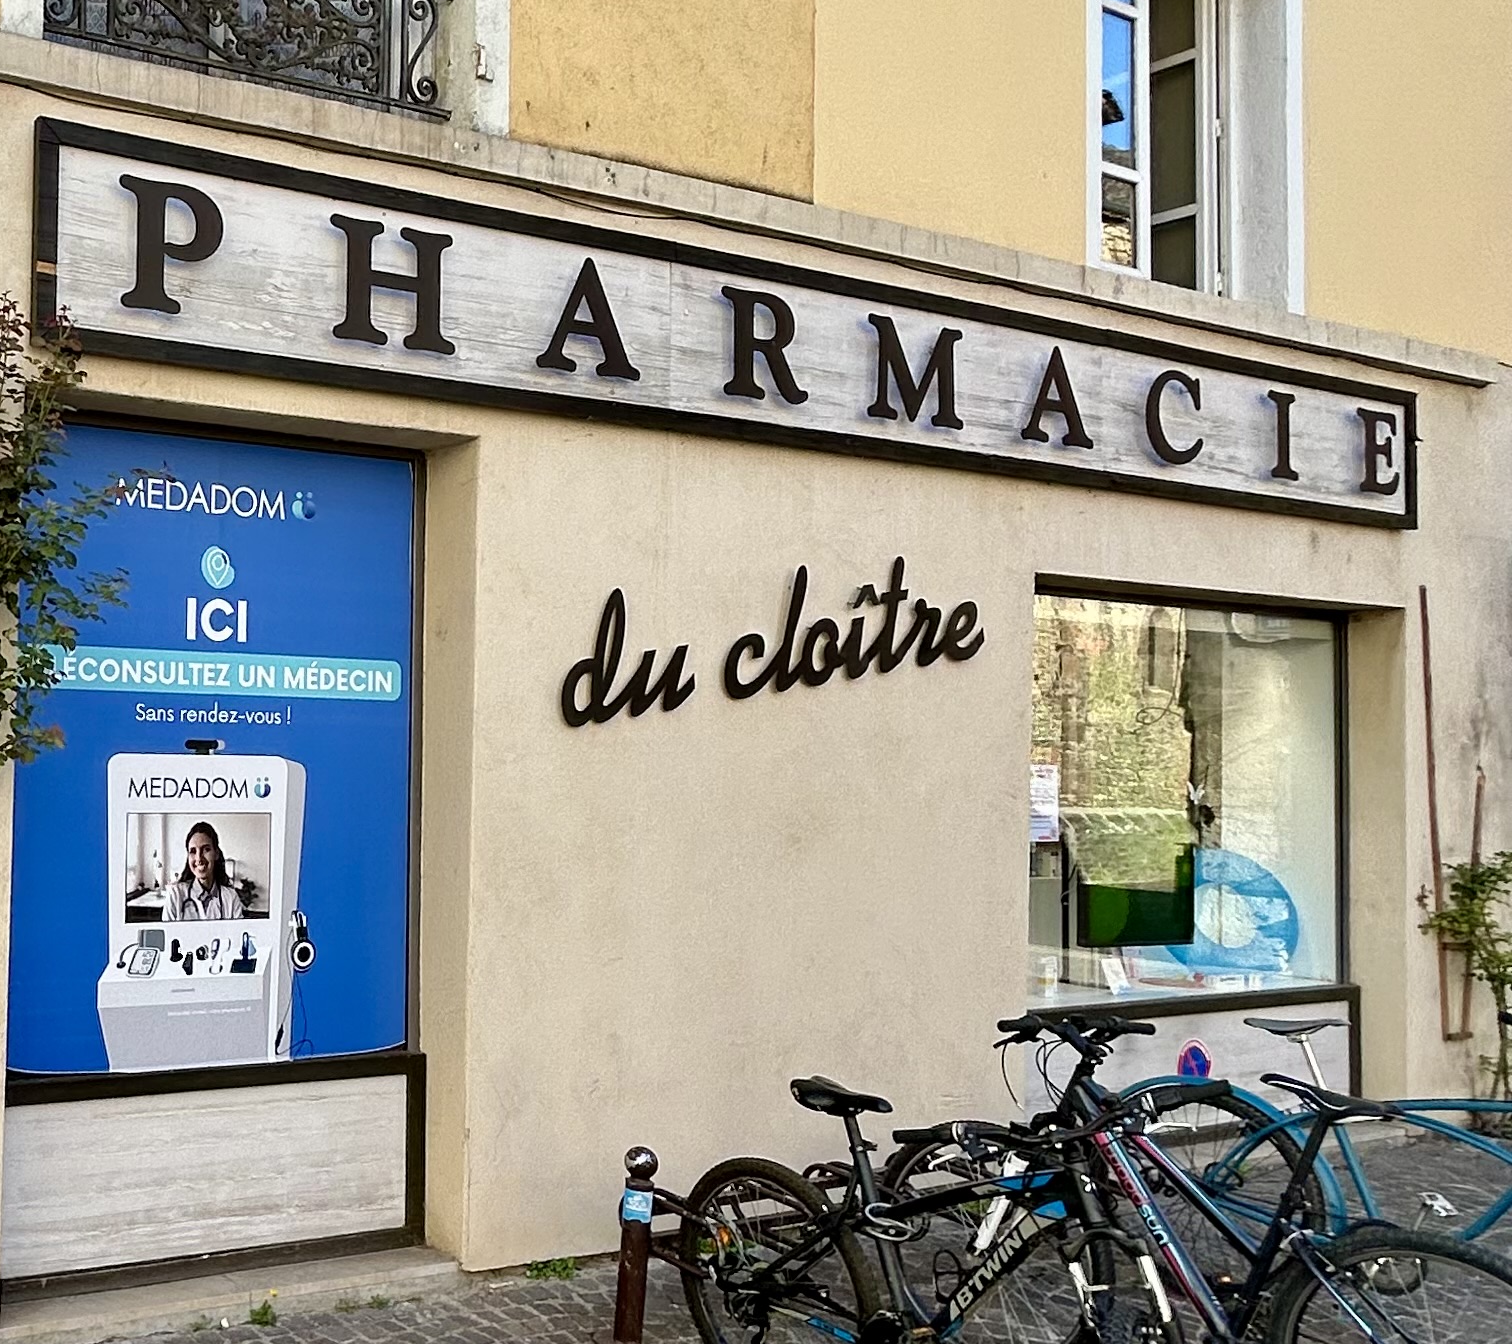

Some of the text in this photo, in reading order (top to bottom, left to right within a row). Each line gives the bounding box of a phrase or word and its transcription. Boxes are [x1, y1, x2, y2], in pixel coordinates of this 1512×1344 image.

[118, 173, 1401, 496] PHARMACIE
[114, 477, 287, 521] MEDADOM
[186, 597, 248, 643] ICI
[561, 556, 986, 728] du cloître
[25, 650, 393, 693] LÉCONSULTEZ UN MÉDECIN
[135, 703, 175, 723] Sans
[180, 701, 282, 725] rendez-vous
[128, 777, 249, 799] MEDADOM
